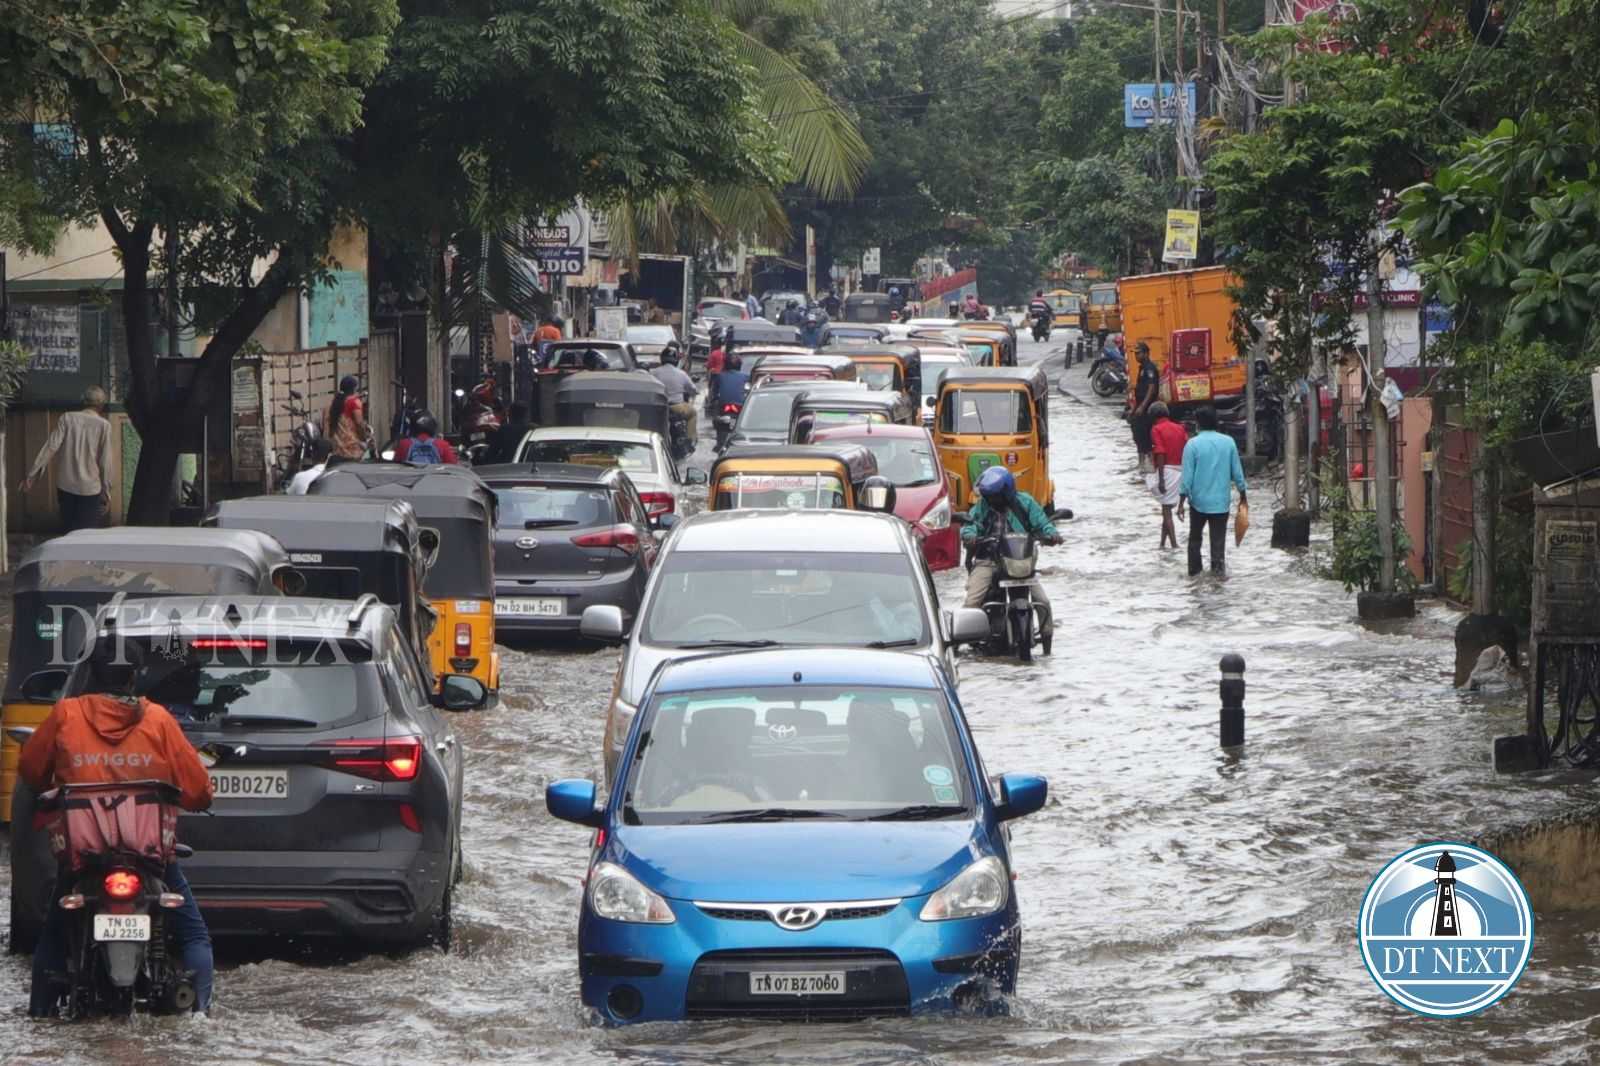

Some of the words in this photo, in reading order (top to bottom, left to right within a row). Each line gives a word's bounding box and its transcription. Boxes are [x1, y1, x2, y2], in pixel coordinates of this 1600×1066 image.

[496, 603, 508, 612] TN
[510, 603, 521, 612] 02
[73, 752, 153, 768] SWIGGY
[107, 917, 121, 927] TN
[125, 917, 137, 927] 03
[103, 928, 116, 938] AJ
[120, 928, 145, 938] 2256
[755, 977, 772, 991] TN
[774, 977, 789, 991] 07
